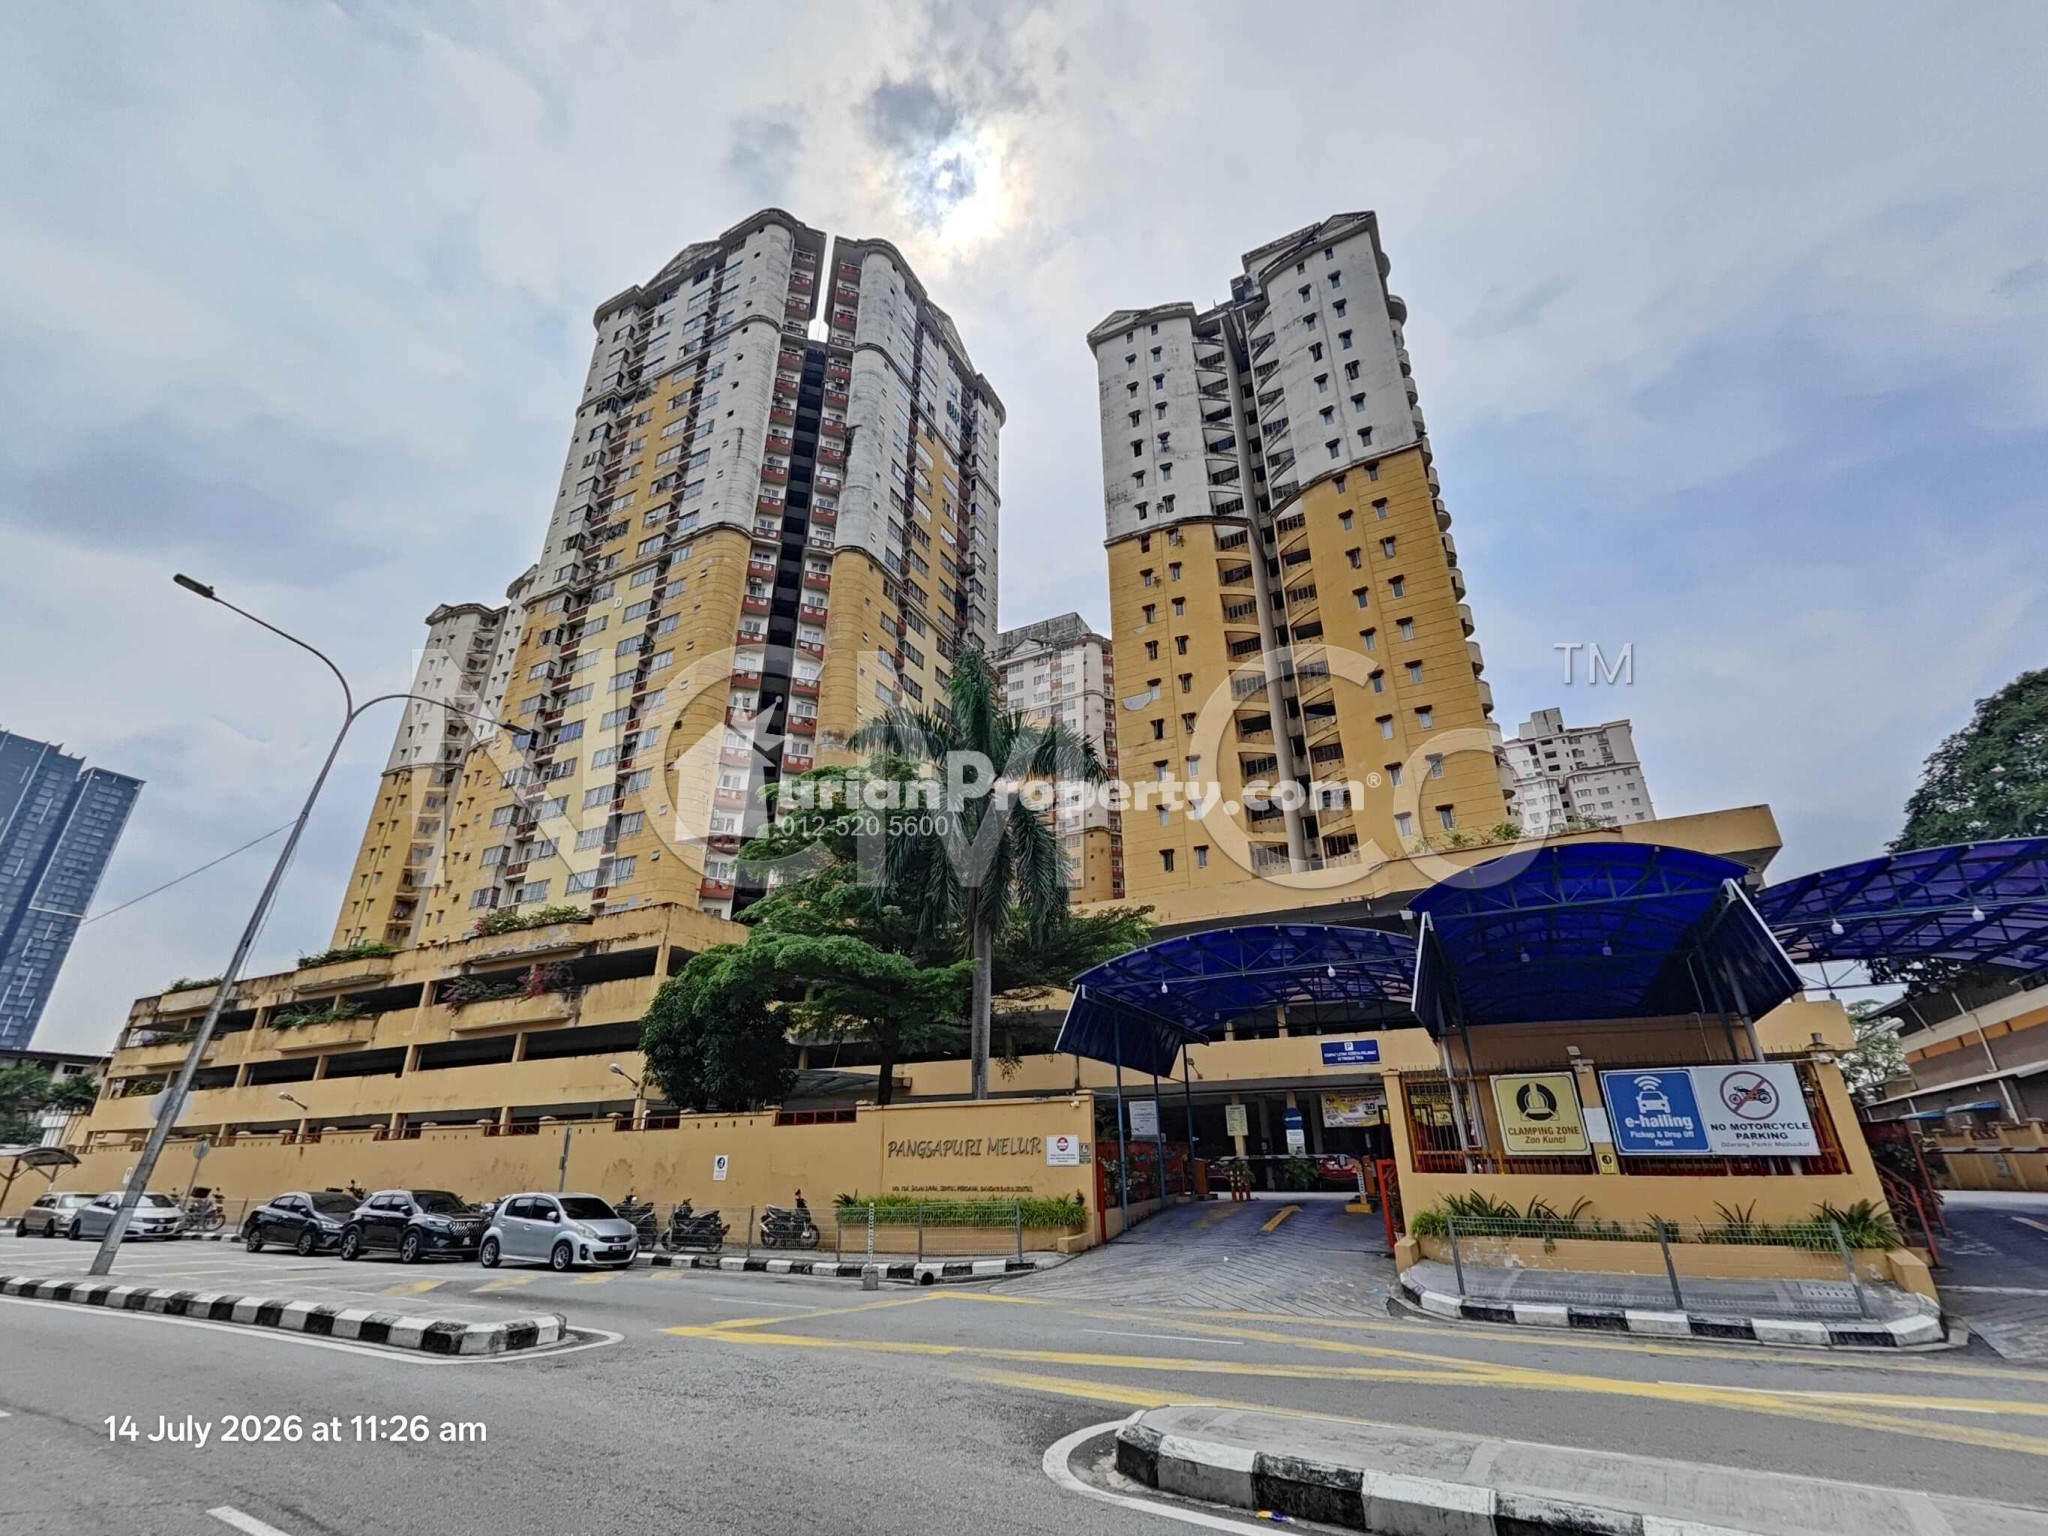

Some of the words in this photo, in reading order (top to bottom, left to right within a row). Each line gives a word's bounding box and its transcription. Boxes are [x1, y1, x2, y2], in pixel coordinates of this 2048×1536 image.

[1624, 1114, 1694, 1130] e-hailing
[1710, 1123, 1727, 1131] NO
[1730, 1122, 1811, 1131] MOTORCYCLE
[1508, 1126, 1554, 1136] CLAMPING
[1555, 1126, 1581, 1135] ZONE
[1630, 1131, 1656, 1139] Pickup
[1664, 1131, 1683, 1139] Drop
[1525, 1136, 1541, 1144] Zon
[1542, 1135, 1566, 1144] Kunci
[1735, 1132, 1789, 1140] PARKING
[887, 1138, 983, 1159] PANGSAPURI
[986, 1136, 1043, 1157] MELUR
[1654, 1139, 1674, 1147] Point
